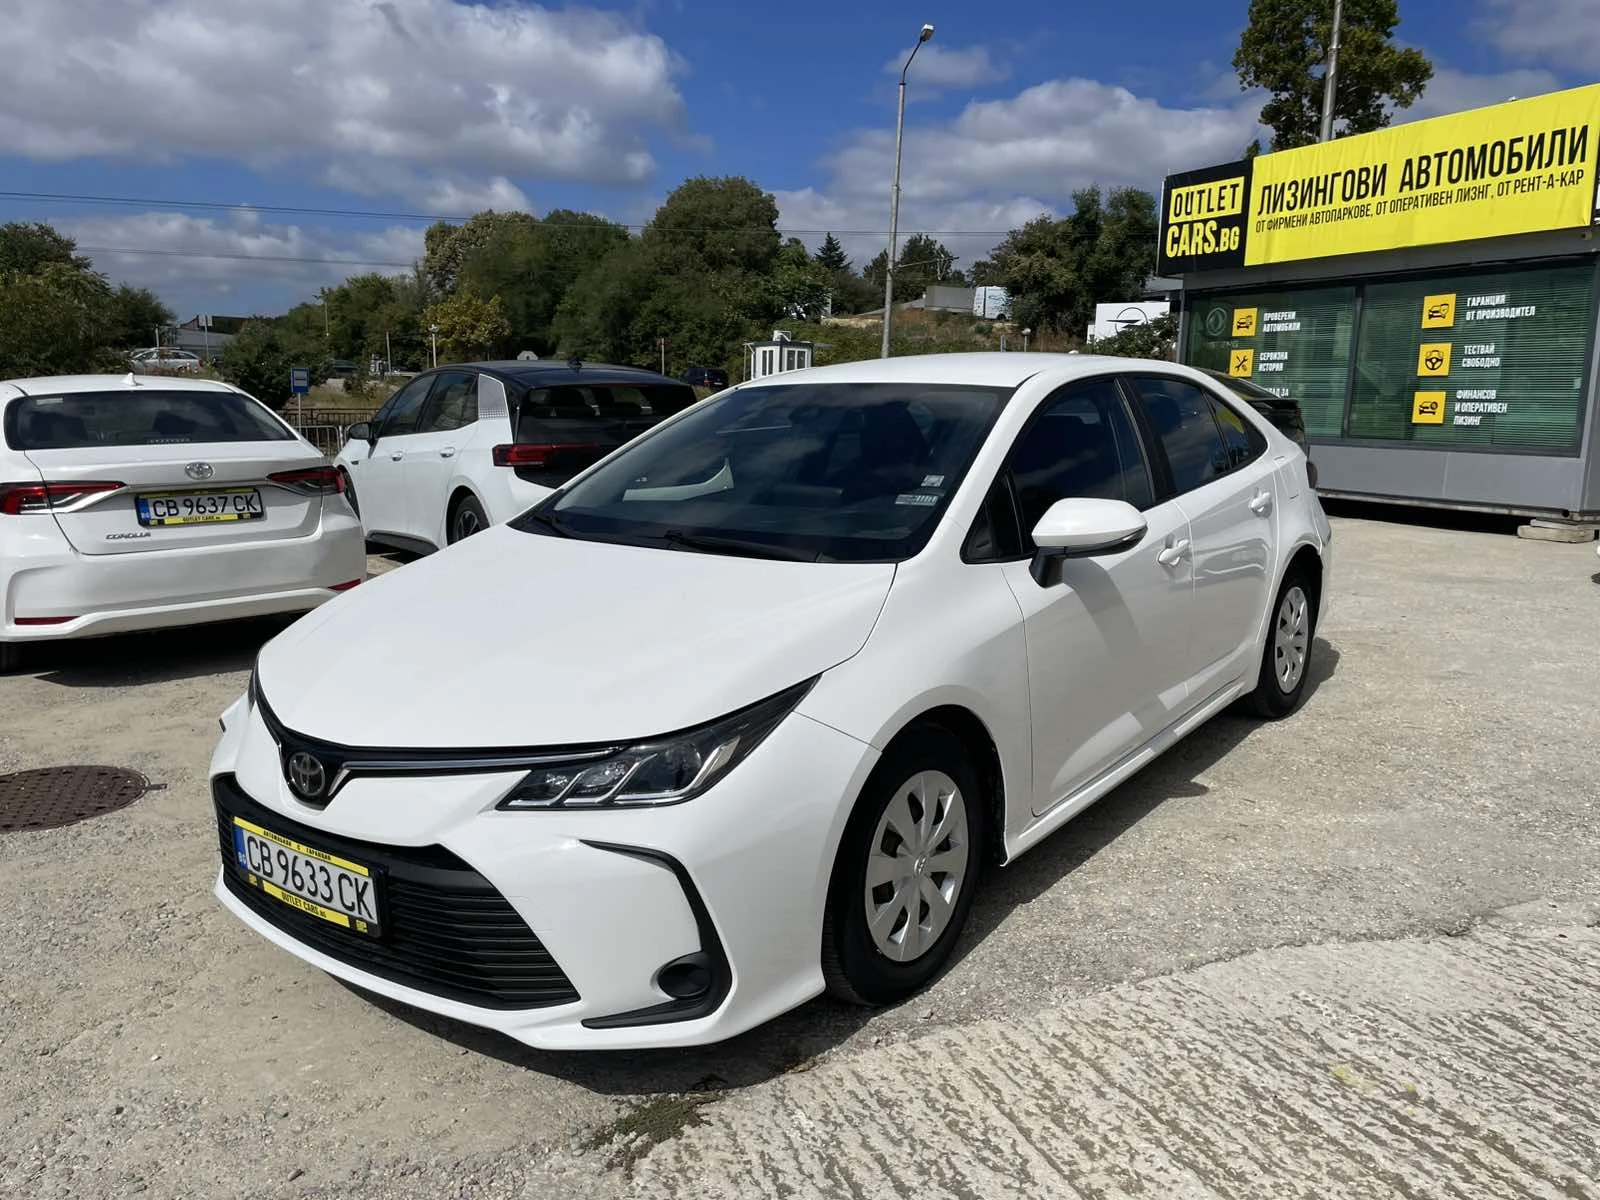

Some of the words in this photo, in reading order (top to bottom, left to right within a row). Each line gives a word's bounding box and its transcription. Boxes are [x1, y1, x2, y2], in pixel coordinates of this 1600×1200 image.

[1257, 162, 1388, 216] ЛИЗИНГОВИ
[1398, 124, 1589, 193] АВТОМОБИЛИ
[1173, 183, 1240, 217] OUTLET
[1255, 220, 1266, 233] ОТ
[1266, 213, 1308, 231] ФИРМЕНИ
[1376, 200, 1388, 215] ОТ
[1389, 190, 1453, 213] ОПЕРАТИВЕН
[1497, 180, 1512, 197] ОТ
[1513, 168, 1584, 194] РЕНТ-А-КАР
[1166, 220, 1240, 258] CARS.BG
[1467, 295, 1506, 307] ГАРАНЦИЯ
[1263, 311, 1296, 321] ПРОВЕРЕНИ
[1465, 311, 1475, 320] ОТ
[1476, 306, 1536, 320] ПРОИЗВОДИТЕЛ
[1262, 322, 1301, 332] АВТОМОБИЛИ
[1463, 343, 1495, 355] ТЕСТВАЙ
[1260, 352, 1288, 361] СЕРВИЗНА
[1461, 357, 1500, 368] СВОБОДНО
[1456, 389, 1497, 400] ФИНАНСОВ
[1461, 402, 1508, 413] ОПЕРАТИВЕН
[1453, 415, 1482, 425] ЛИЗИНГ
[183, 496, 228, 515] 9637
[105, 532, 151, 540] COROLLA
[276, 849, 334, 903] 9633
